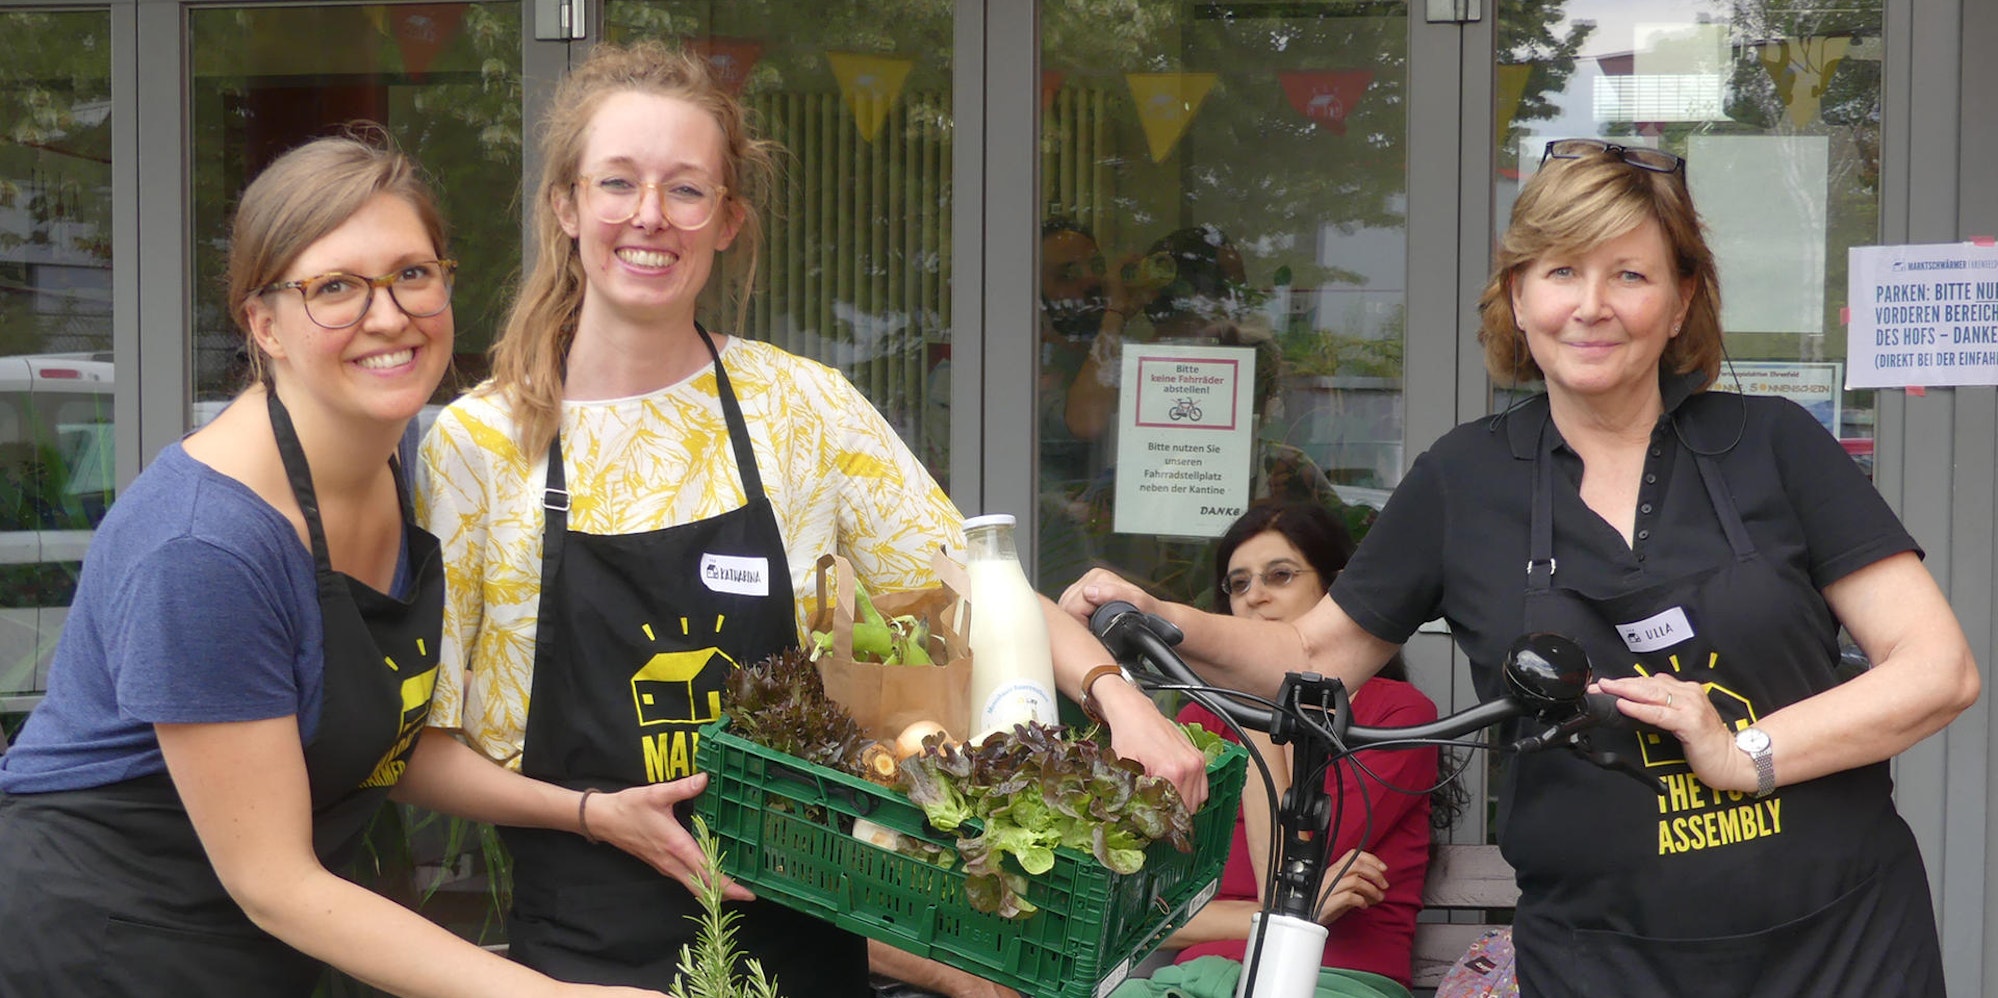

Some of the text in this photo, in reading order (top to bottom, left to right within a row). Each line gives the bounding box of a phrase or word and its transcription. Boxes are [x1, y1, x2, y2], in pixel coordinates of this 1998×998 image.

[1876, 284, 1930, 303] PARKEN:
[1935, 282, 1972, 301] BITTE
[1875, 304, 1998, 324] VORDEREN BEREICH
[1876, 328, 1899, 346] DES
[1903, 327, 1936, 345] HOFS
[1953, 326, 1998, 344] DANKE
[1875, 353, 1914, 370] (DIREKT
[1917, 352, 1933, 367] BEI
[1936, 352, 1956, 366] DER
[1176, 364, 1199, 374] Bitte
[1151, 374, 1224, 385] keine Fahrräder
[1163, 385, 1210, 395] abstellen!
[1148, 442, 1220, 453] Bitte nutzen Sie
[1165, 457, 1202, 466] unseren
[1144, 469, 1222, 482] Fahrradstellplatz
[1139, 483, 1225, 495] neben der Kantine
[720, 567, 761, 583] KATHARINA
[1645, 622, 1674, 641] ULLA
[1658, 798, 1782, 855] ASSEMBLY
